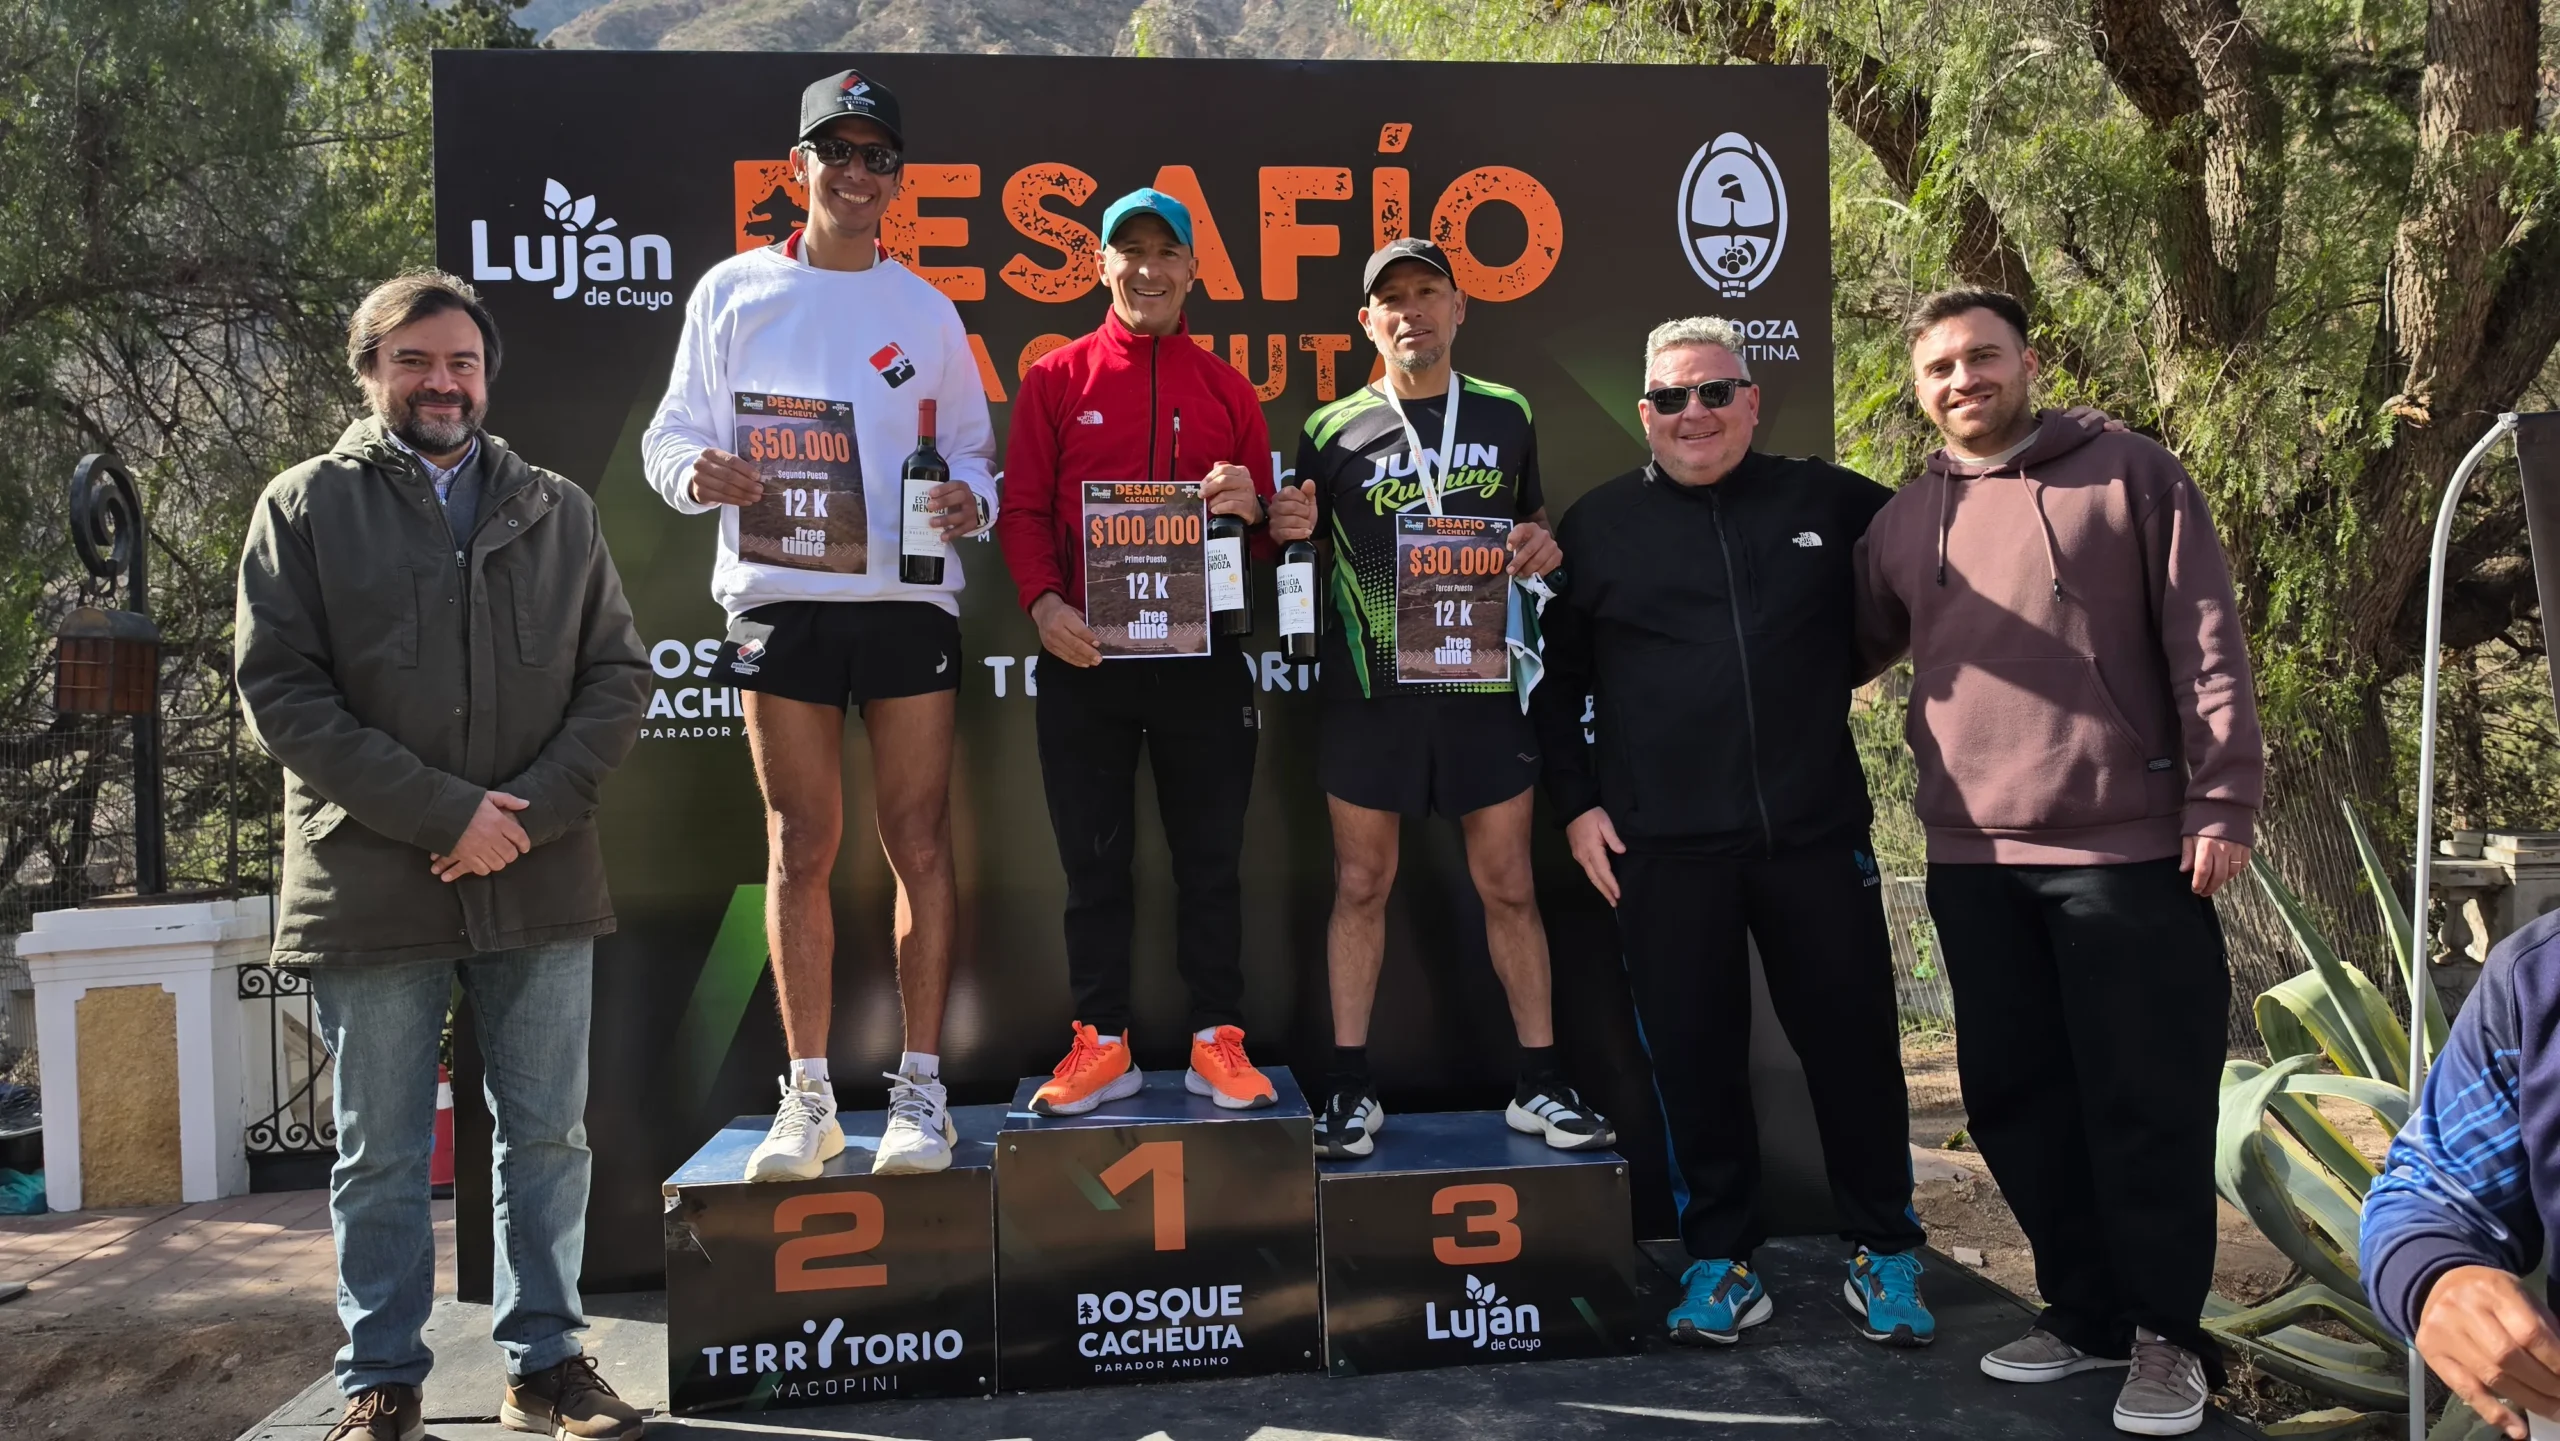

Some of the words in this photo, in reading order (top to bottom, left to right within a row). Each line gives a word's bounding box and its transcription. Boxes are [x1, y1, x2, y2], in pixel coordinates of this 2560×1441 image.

[471, 217, 673, 300] Luján
[584, 286, 611, 306] de
[616, 286, 673, 311] Cuyo
[1728, 319, 1800, 339] DOZA
[777, 409, 818, 419] CACHEUTA
[749, 427, 850, 463] $50.000
[778, 470, 806, 480] Segundo
[806, 470, 828, 480] Puesto
[782, 488, 807, 517] 12
[813, 488, 829, 518] k
[795, 526, 826, 542] free
[1091, 515, 1200, 548] $100.000
[781, 536, 826, 557] time
[1124, 555, 1145, 563] Primer
[1146, 555, 1167, 563] Puesto
[1208, 553, 1228, 562] TANCIA
[1208, 560, 1231, 571] ENDOZA
[1409, 545, 1504, 577] $30.000
[1126, 572, 1149, 599] 12
[1155, 572, 1169, 599] k
[1278, 585, 1303, 596] ENDOZA
[1435, 584, 1453, 592] Tercer
[1454, 584, 1474, 592] Puesto
[1140, 609, 1168, 623] free
[1433, 600, 1455, 626] 12
[1460, 600, 1473, 626] k
[1127, 621, 1168, 639] time
[1445, 635, 1472, 650] free
[1434, 646, 1472, 665] time
[640, 727, 731, 739] PARADOR
[1099, 1141, 1186, 1251] 1
[1432, 1183, 1522, 1265] 3
[773, 1191, 887, 1293] 2
[1077, 1285, 1243, 1325] BOSQUE
[1426, 1295, 1540, 1348] Luján
[1078, 1324, 1244, 1358] CACHEUTA
[1490, 1339, 1506, 1350] de
[1508, 1337, 1541, 1351] Cuyo
[1095, 1360, 1165, 1373] PARADOR
[1172, 1356, 1229, 1368] ANDINO
[772, 1375, 898, 1399] YACOPINI
